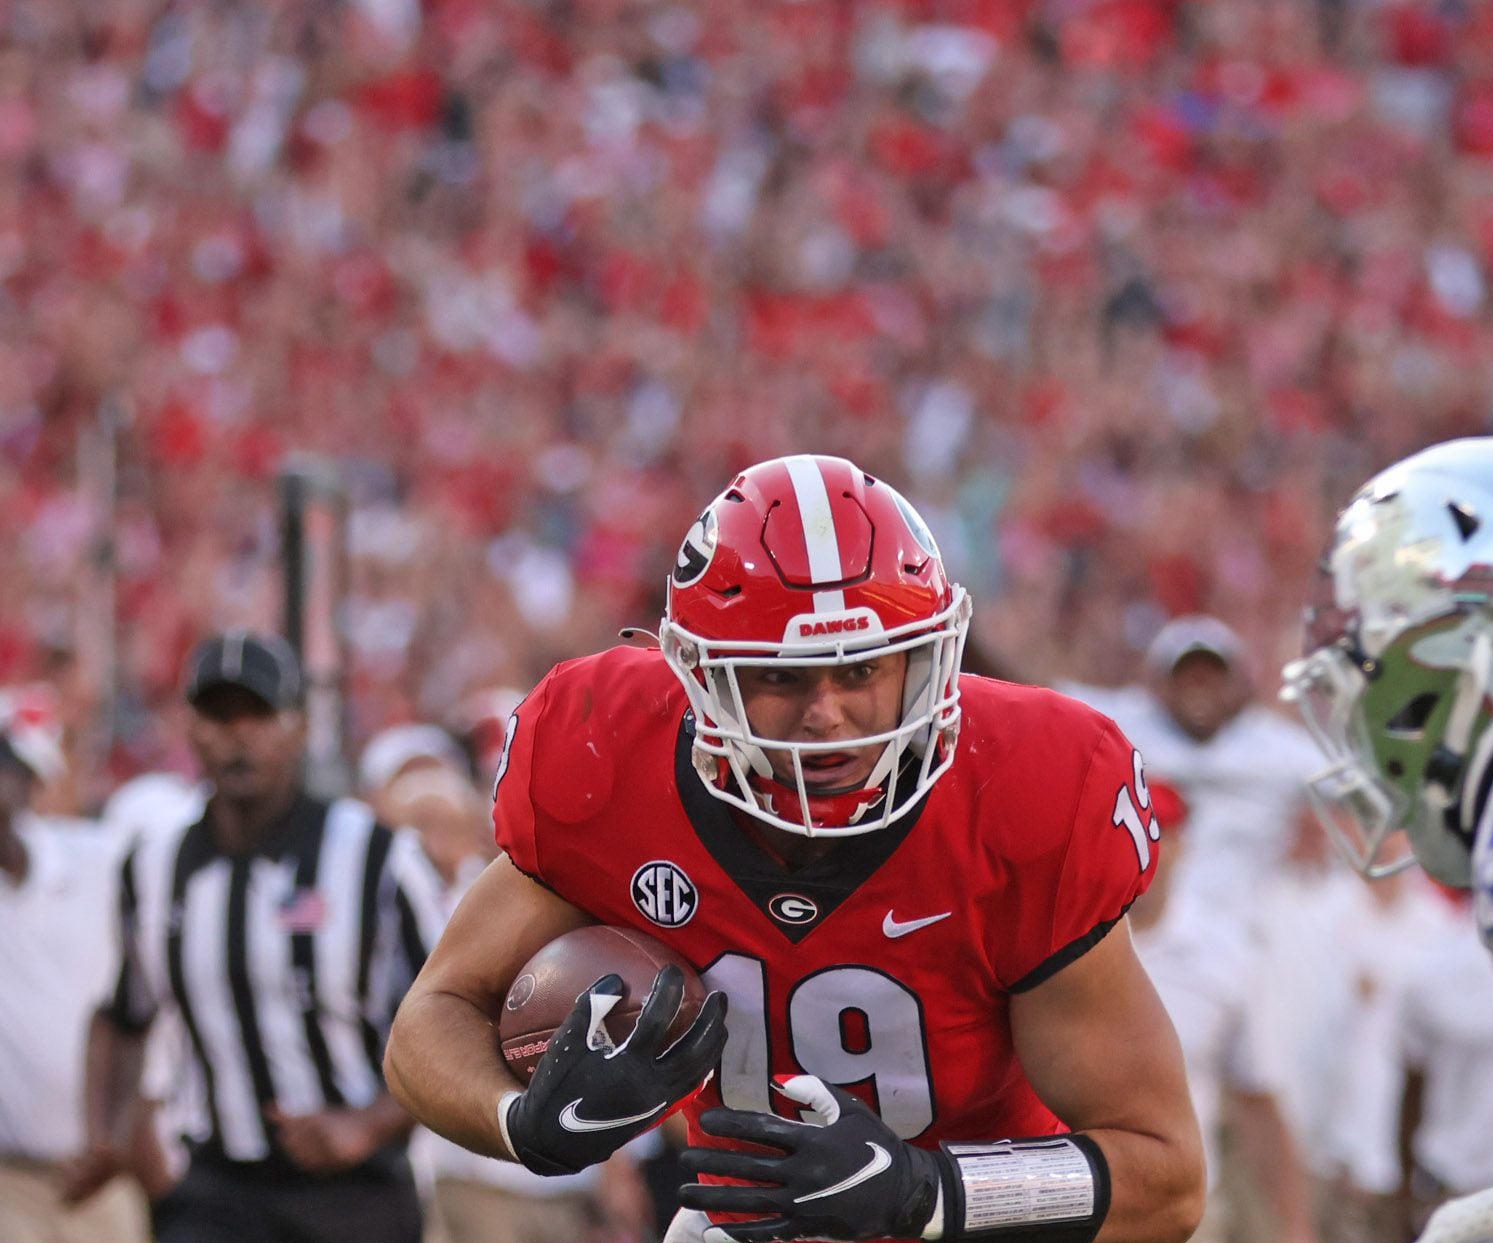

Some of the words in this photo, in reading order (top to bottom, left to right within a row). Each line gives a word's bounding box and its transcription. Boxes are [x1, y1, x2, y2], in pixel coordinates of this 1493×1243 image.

[799, 616, 870, 637] DAWGS
[636, 865, 692, 924] SEC
[775, 895, 817, 922] G
[700, 951, 938, 1142] 19
